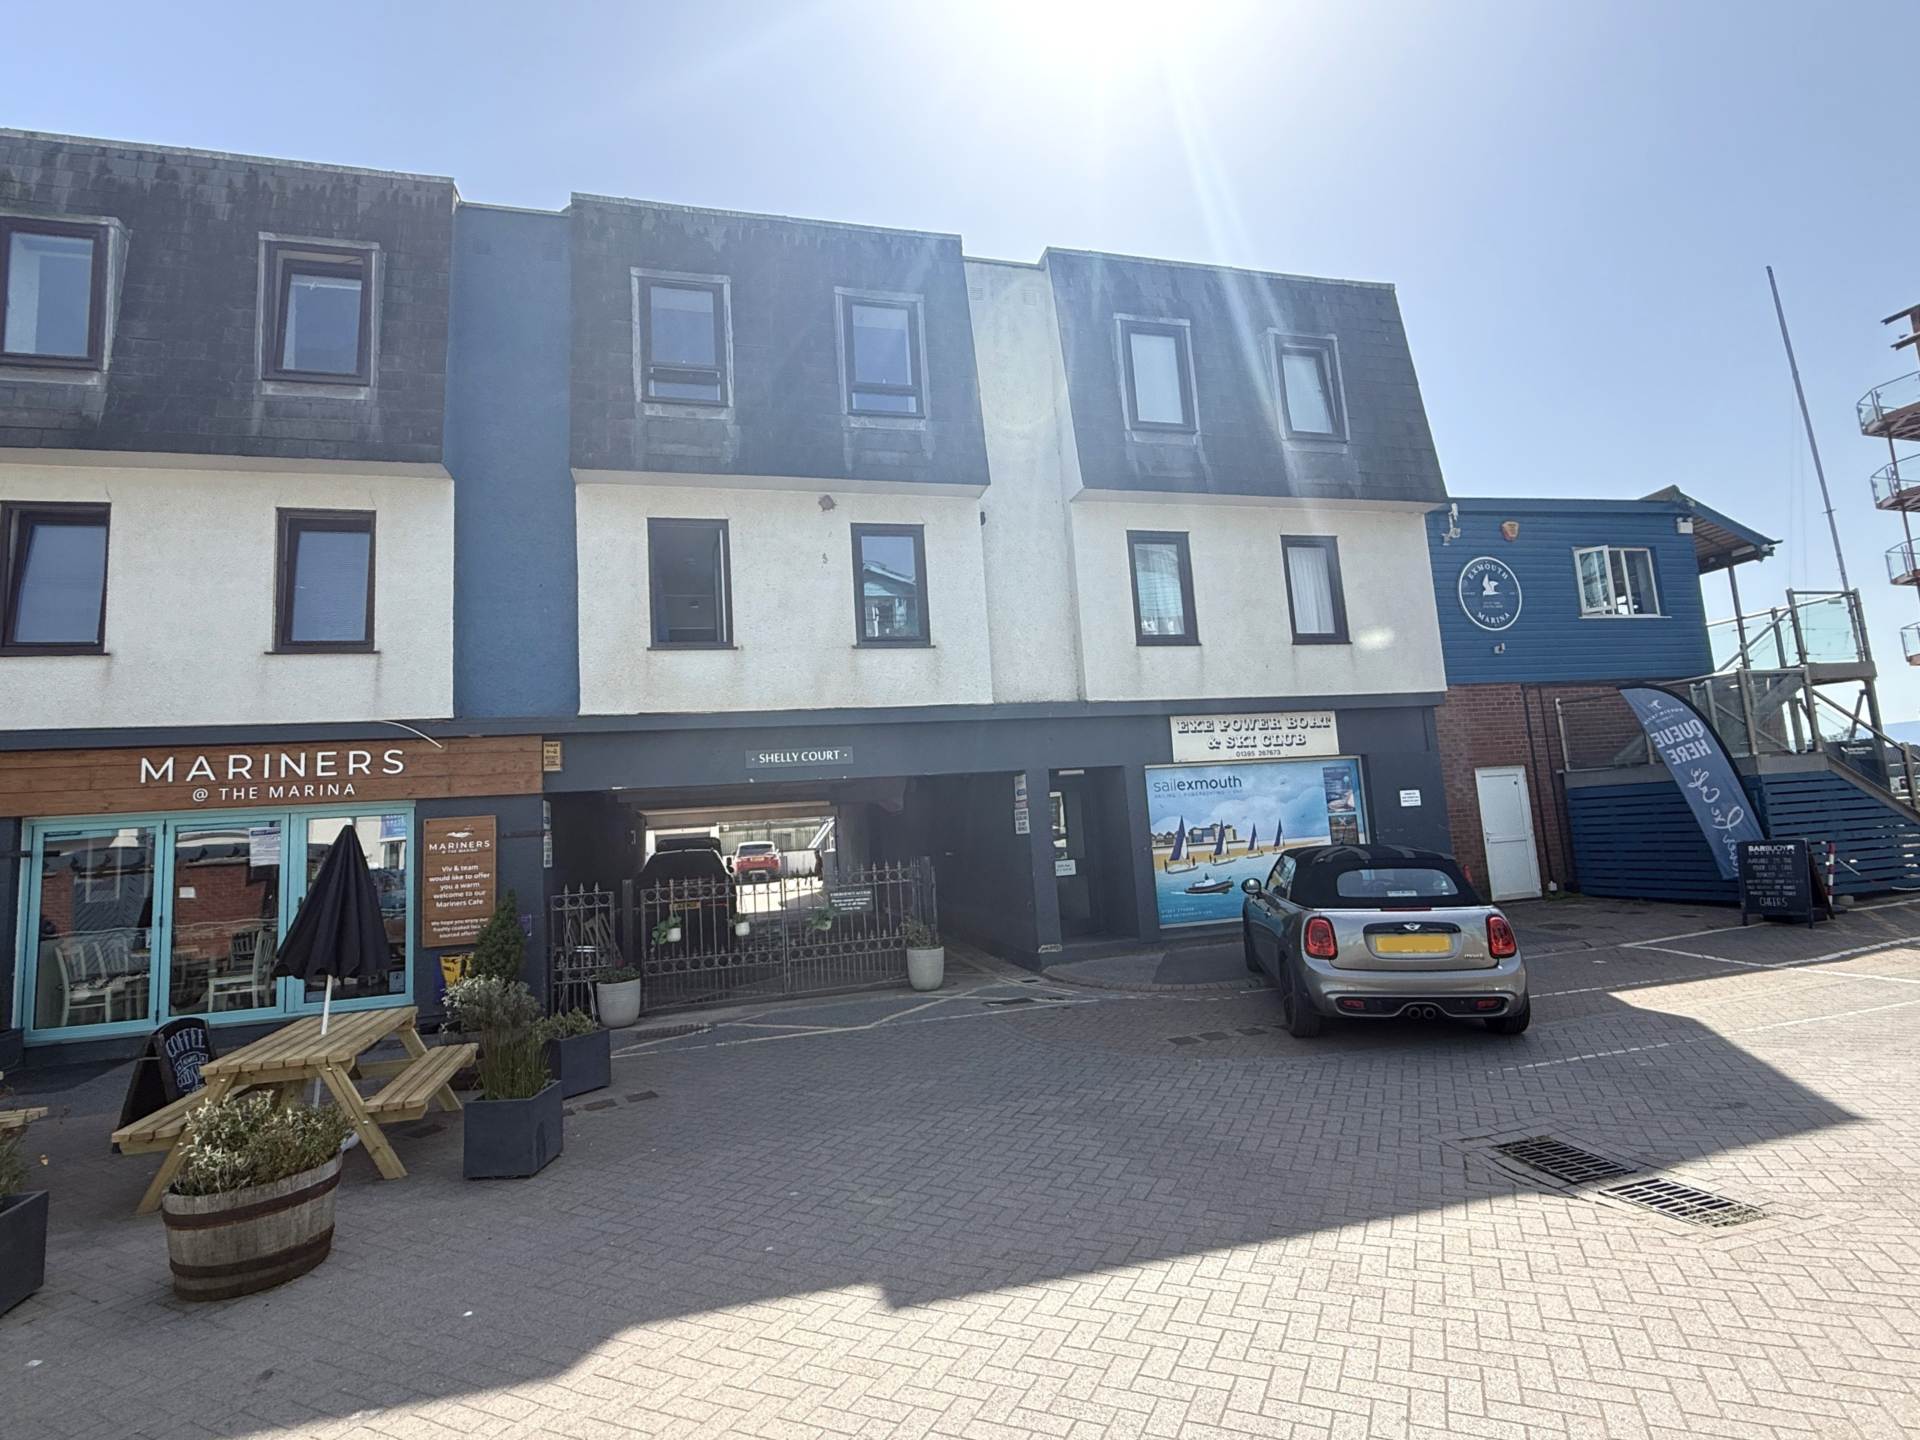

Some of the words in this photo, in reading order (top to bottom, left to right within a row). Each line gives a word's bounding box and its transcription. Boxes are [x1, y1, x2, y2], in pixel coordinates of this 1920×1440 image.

[1467, 563, 1509, 580] EXMOUTH
[1477, 611, 1511, 624] MARINA
[1177, 720, 1214, 734] EXE
[1219, 717, 1282, 732] POWER
[1286, 715, 1331, 729] BOAT
[1207, 735, 1221, 749] &
[1226, 734, 1257, 748] SKI
[1262, 733, 1307, 746] CLUB
[759, 752, 799, 764] SHELLY
[801, 750, 840, 762] COURT
[140, 749, 404, 784] MARINERS
[192, 788, 209, 802] @
[220, 787, 258, 800] THE
[269, 783, 355, 798] MARINA
[428, 839, 491, 851] MARINERS
[428, 874, 450, 882] would
[451, 873, 464, 881] like
[473, 871, 490, 879] offer
[440, 883, 453, 891] you
[433, 891, 464, 899] welcome
[435, 900, 467, 908] Mariners
[166, 1027, 206, 1058] COFFEE
